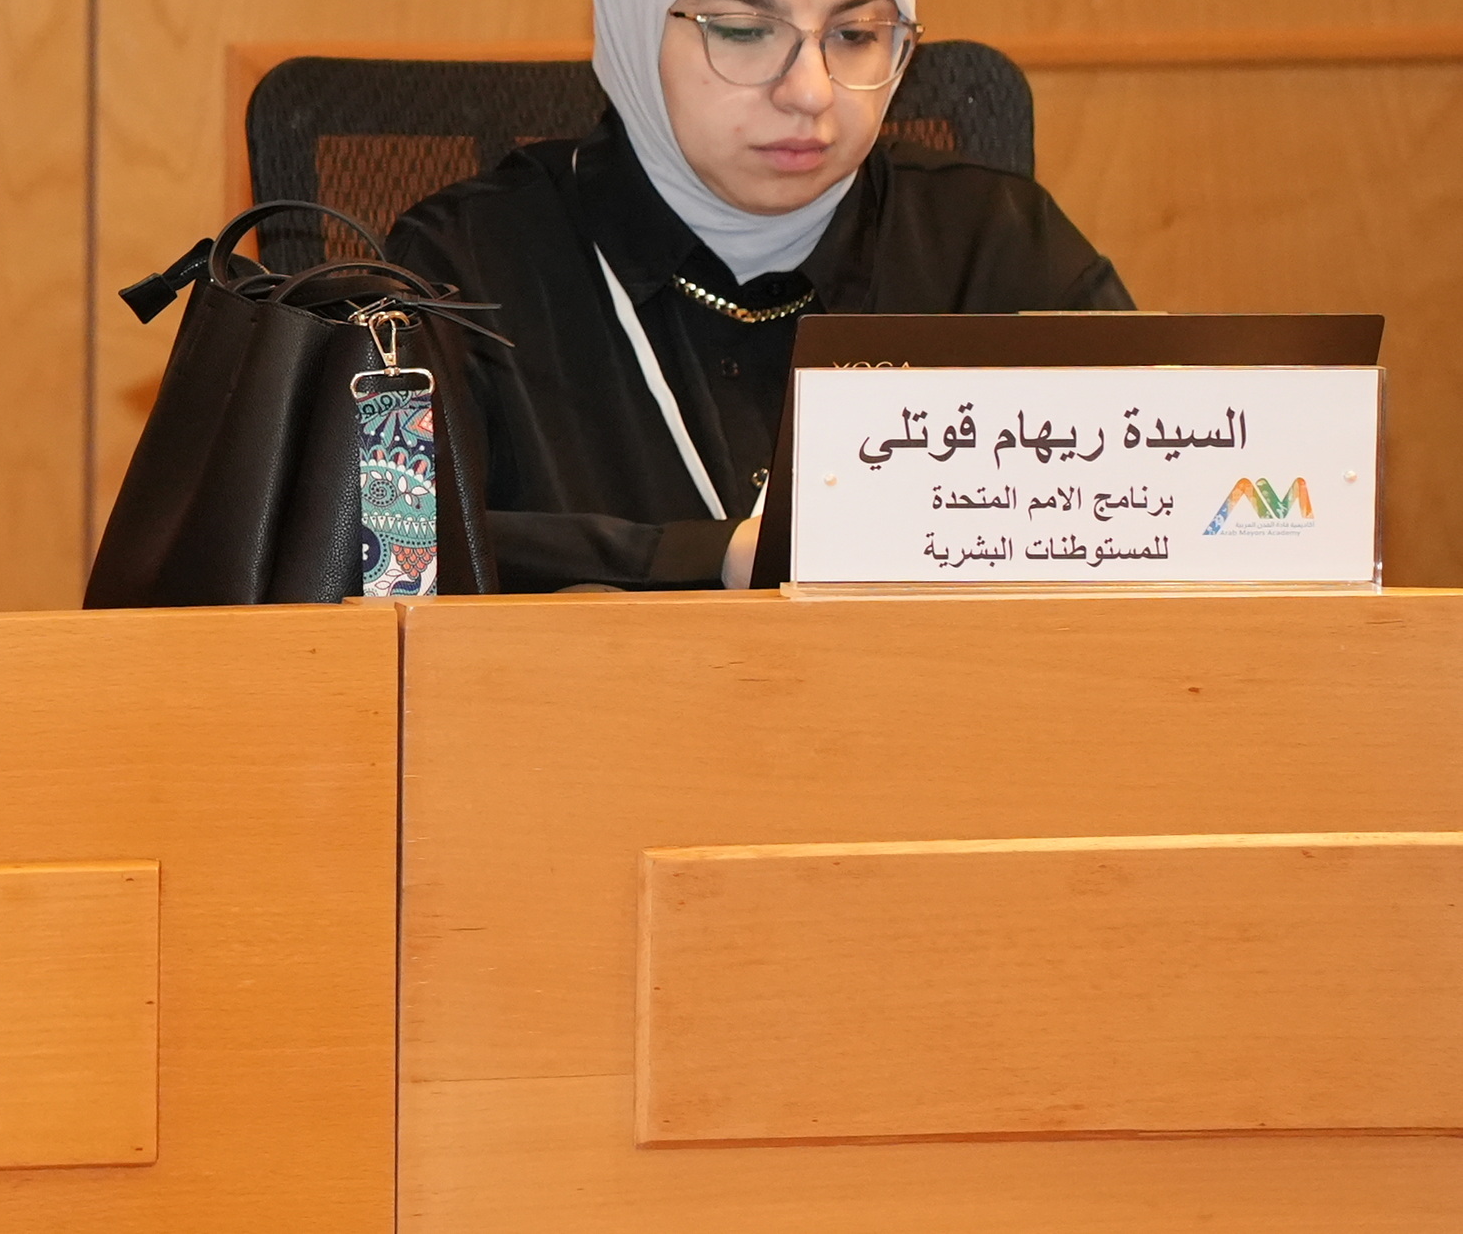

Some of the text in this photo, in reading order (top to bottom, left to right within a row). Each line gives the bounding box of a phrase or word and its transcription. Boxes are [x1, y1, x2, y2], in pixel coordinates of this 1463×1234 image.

[858, 401, 1247, 471] السيدة ريهام قوتلي
[932, 484, 1174, 522] برنامج الامم المتحدة
[923, 531, 1169, 568] للمستوطنات البشرية
